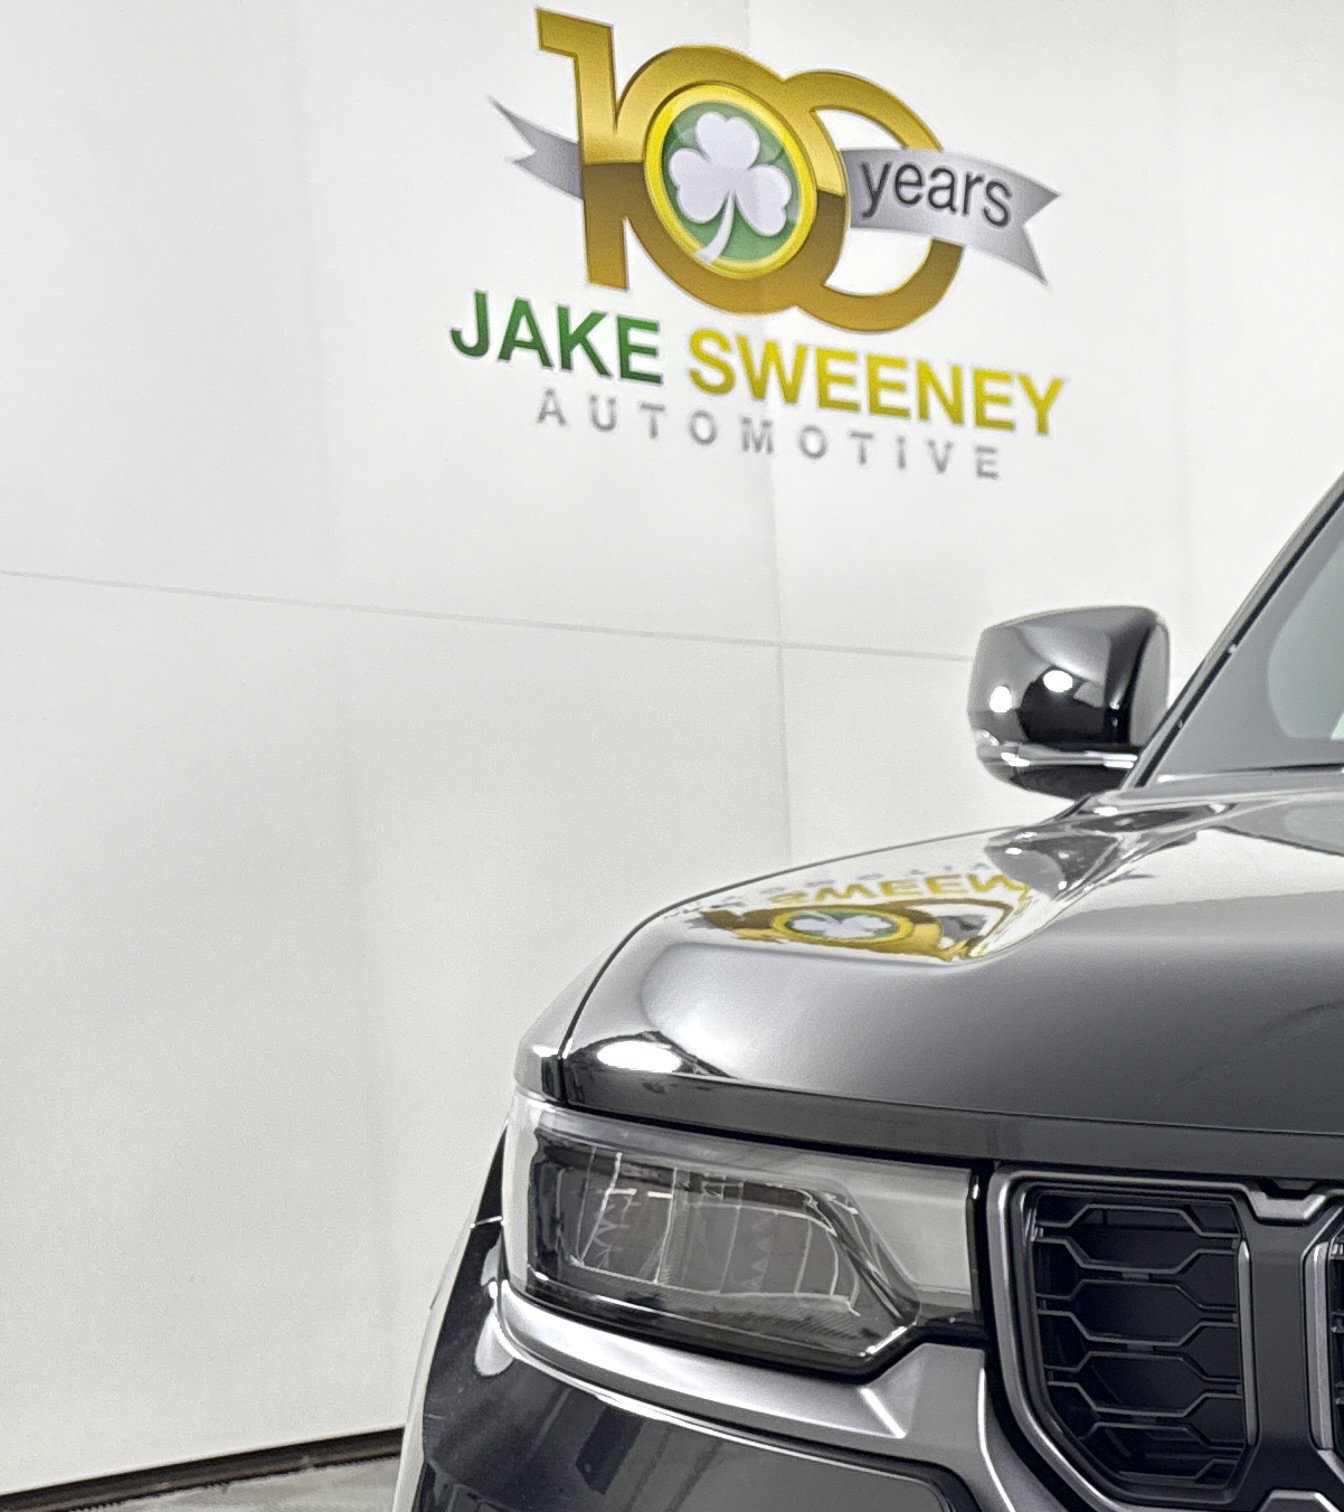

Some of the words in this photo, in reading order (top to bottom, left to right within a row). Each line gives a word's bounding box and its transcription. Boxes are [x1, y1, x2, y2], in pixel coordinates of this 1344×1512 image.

[536, 9, 963, 333] 100
[861, 160, 1012, 228] years
[450, 291, 662, 385] JAKE
[688, 327, 1064, 435] SWEENEY
[536, 388, 1000, 479] AUTOMOTIVE
